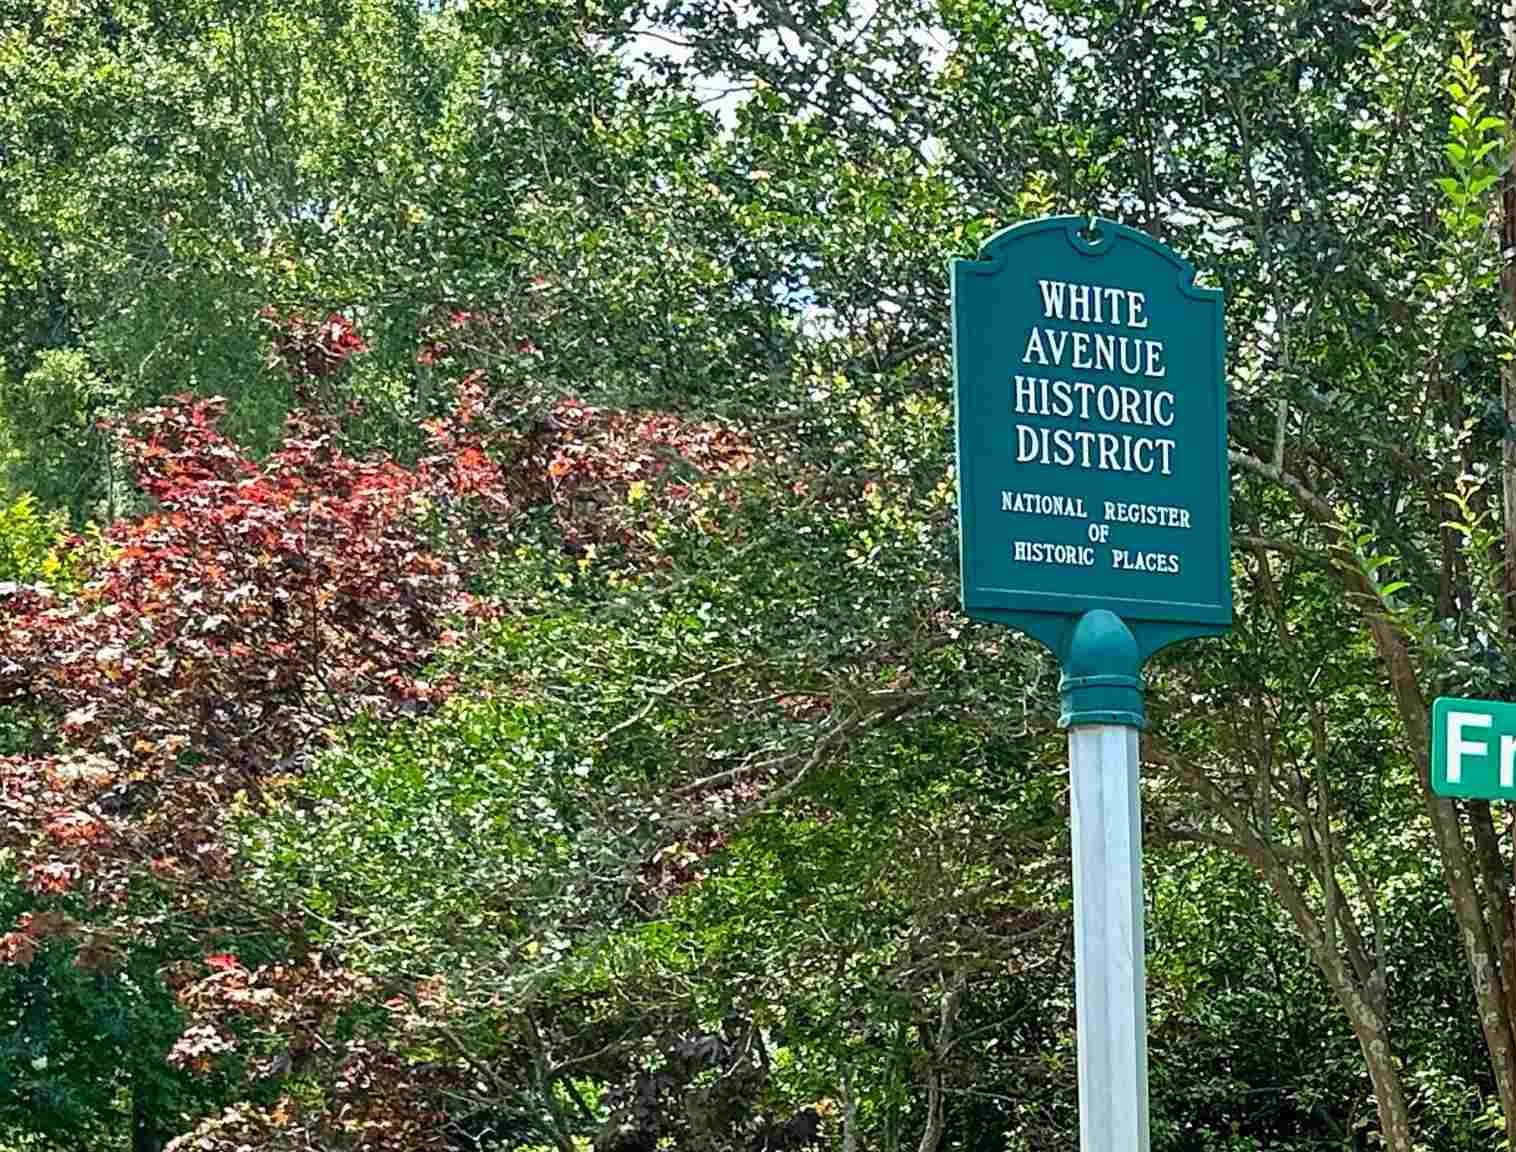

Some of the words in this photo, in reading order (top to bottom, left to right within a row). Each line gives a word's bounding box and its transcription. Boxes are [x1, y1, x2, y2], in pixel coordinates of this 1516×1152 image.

[1039, 280, 1148, 328] WHITE
[1022, 326, 1165, 376] AVENUE
[1013, 375, 1175, 427] HISTORIC
[1016, 426, 1176, 475] DISTRICT
[1001, 491, 1088, 519] NATIONAL
[1103, 501, 1191, 529] REGISTER
[1088, 523, 1110, 542] OF
[1013, 541, 1095, 567] HISTORIC
[1111, 550, 1180, 574] PLACES
